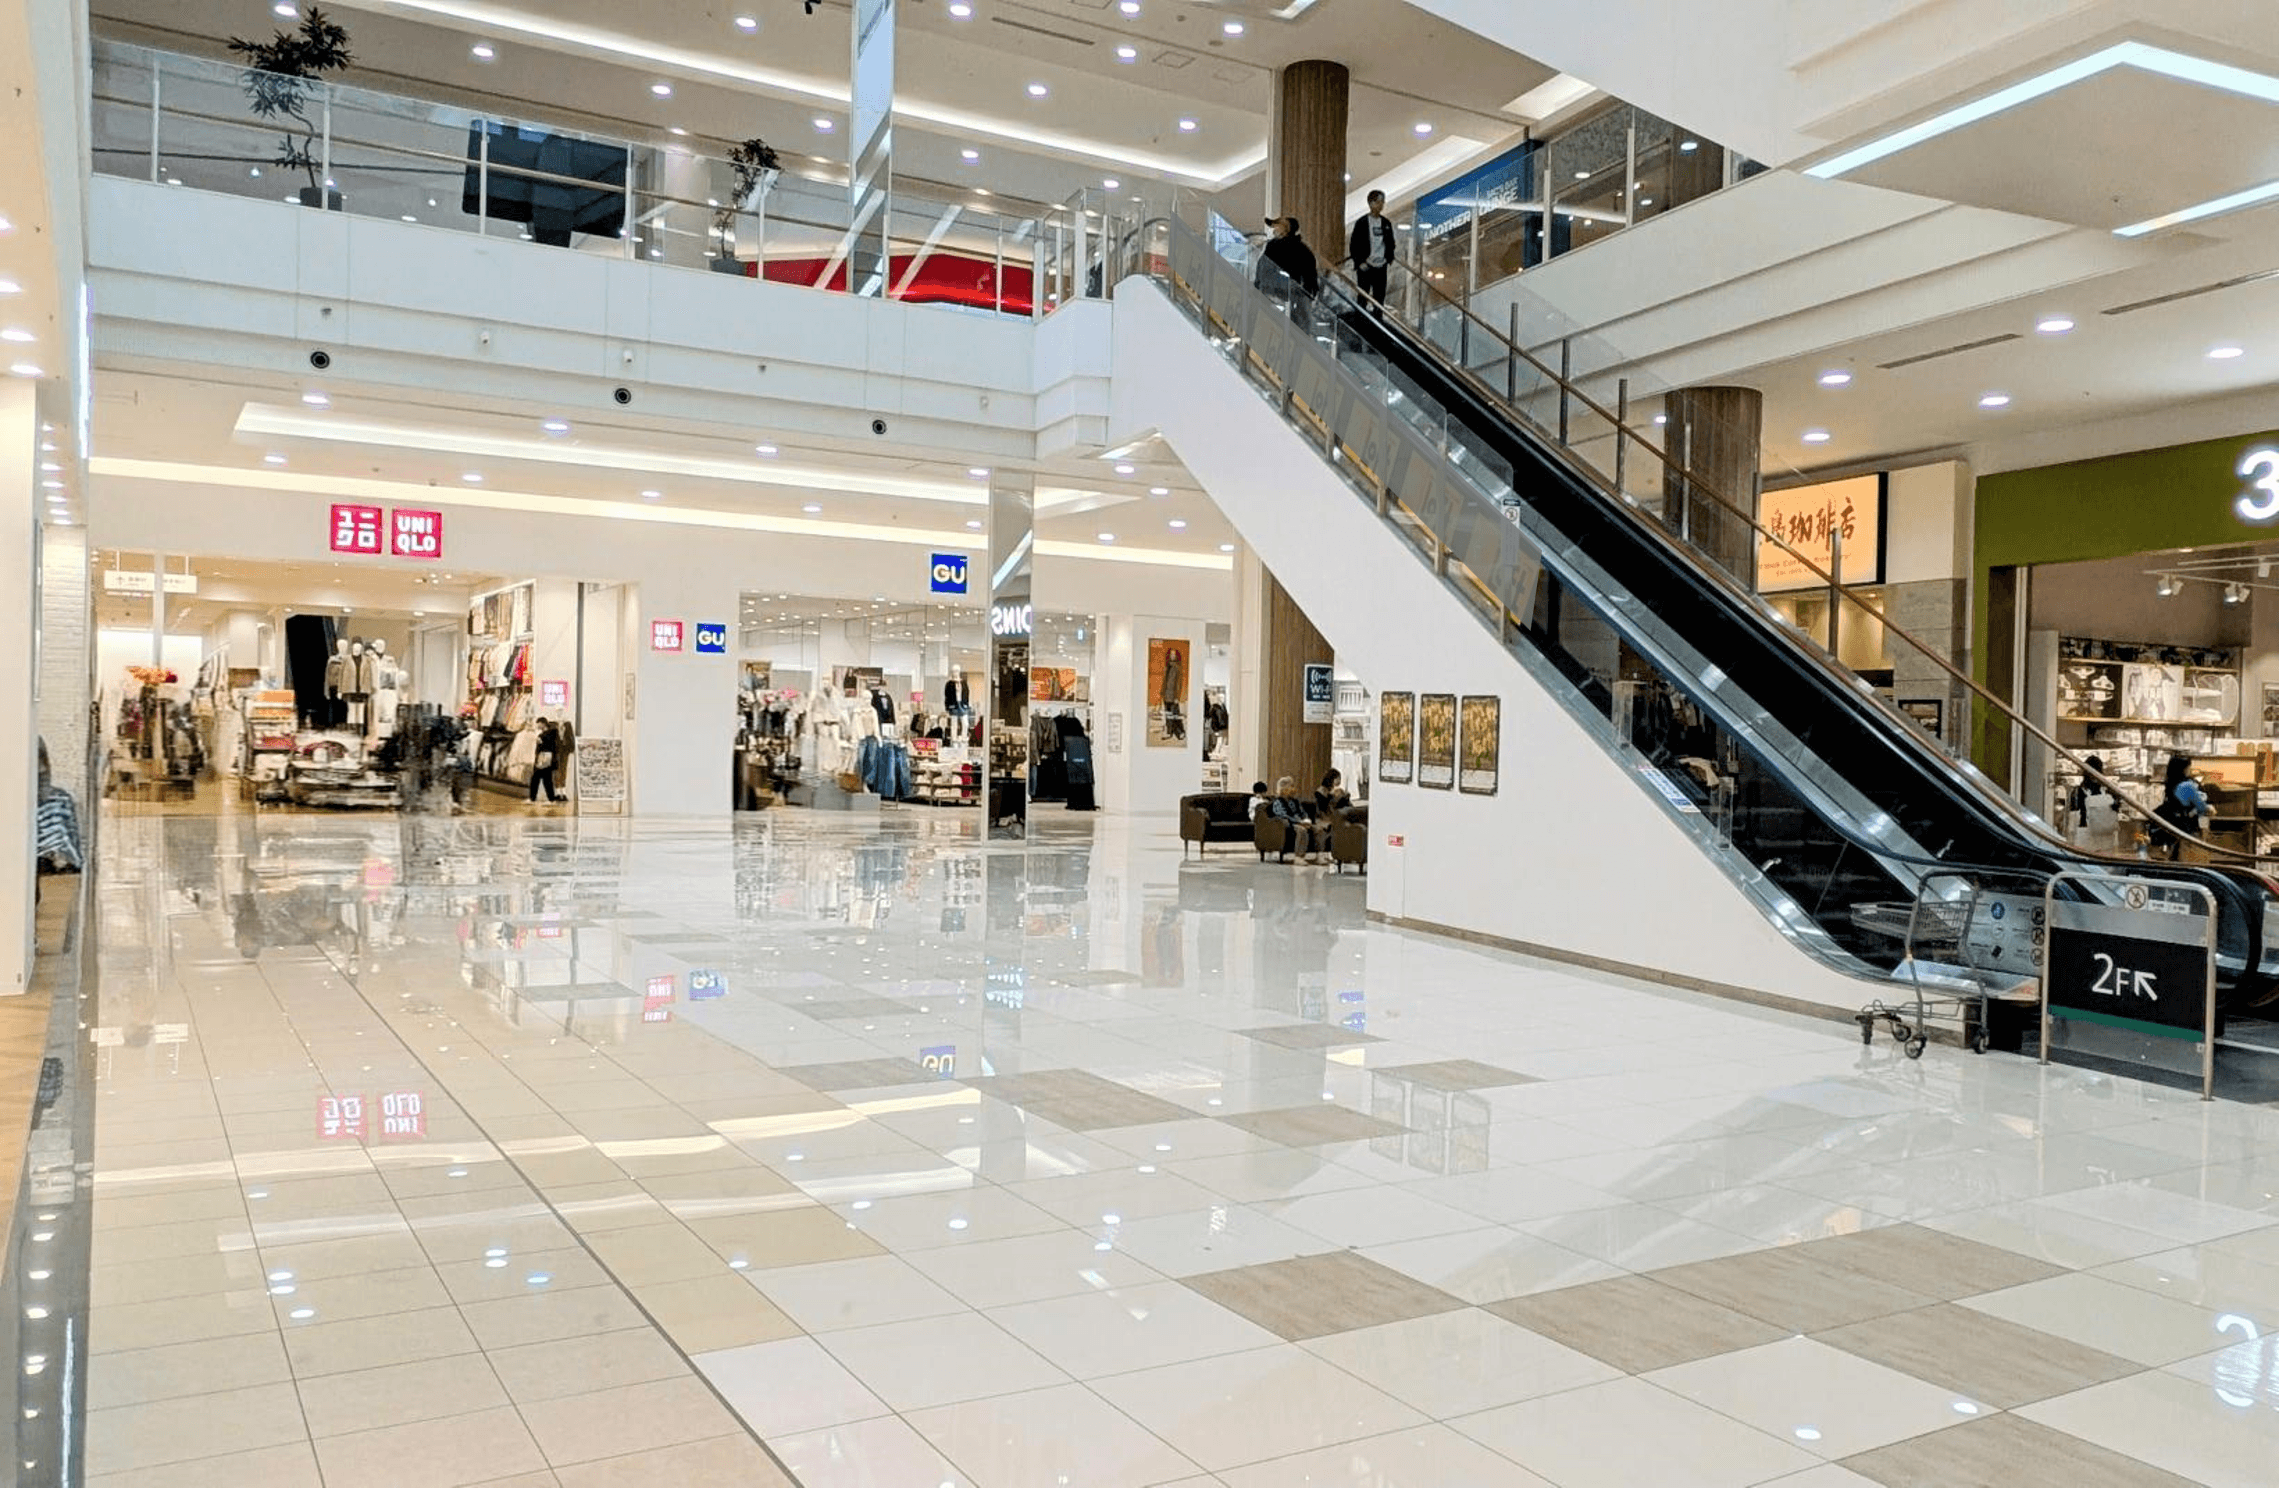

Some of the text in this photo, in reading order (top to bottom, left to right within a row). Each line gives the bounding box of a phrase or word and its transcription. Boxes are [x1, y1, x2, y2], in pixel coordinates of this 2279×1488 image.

[1478, 186, 1518, 216] OUNGE
[337, 510, 376, 529] ユニ
[397, 515, 433, 533] UNI
[1758, 496, 1856, 552] 島珈琲店
[397, 533, 436, 553] QLO
[933, 563, 965, 584] GU
[655, 624, 678, 636] UNI
[698, 630, 725, 646] GU
[2092, 952, 2130, 996] 2F
